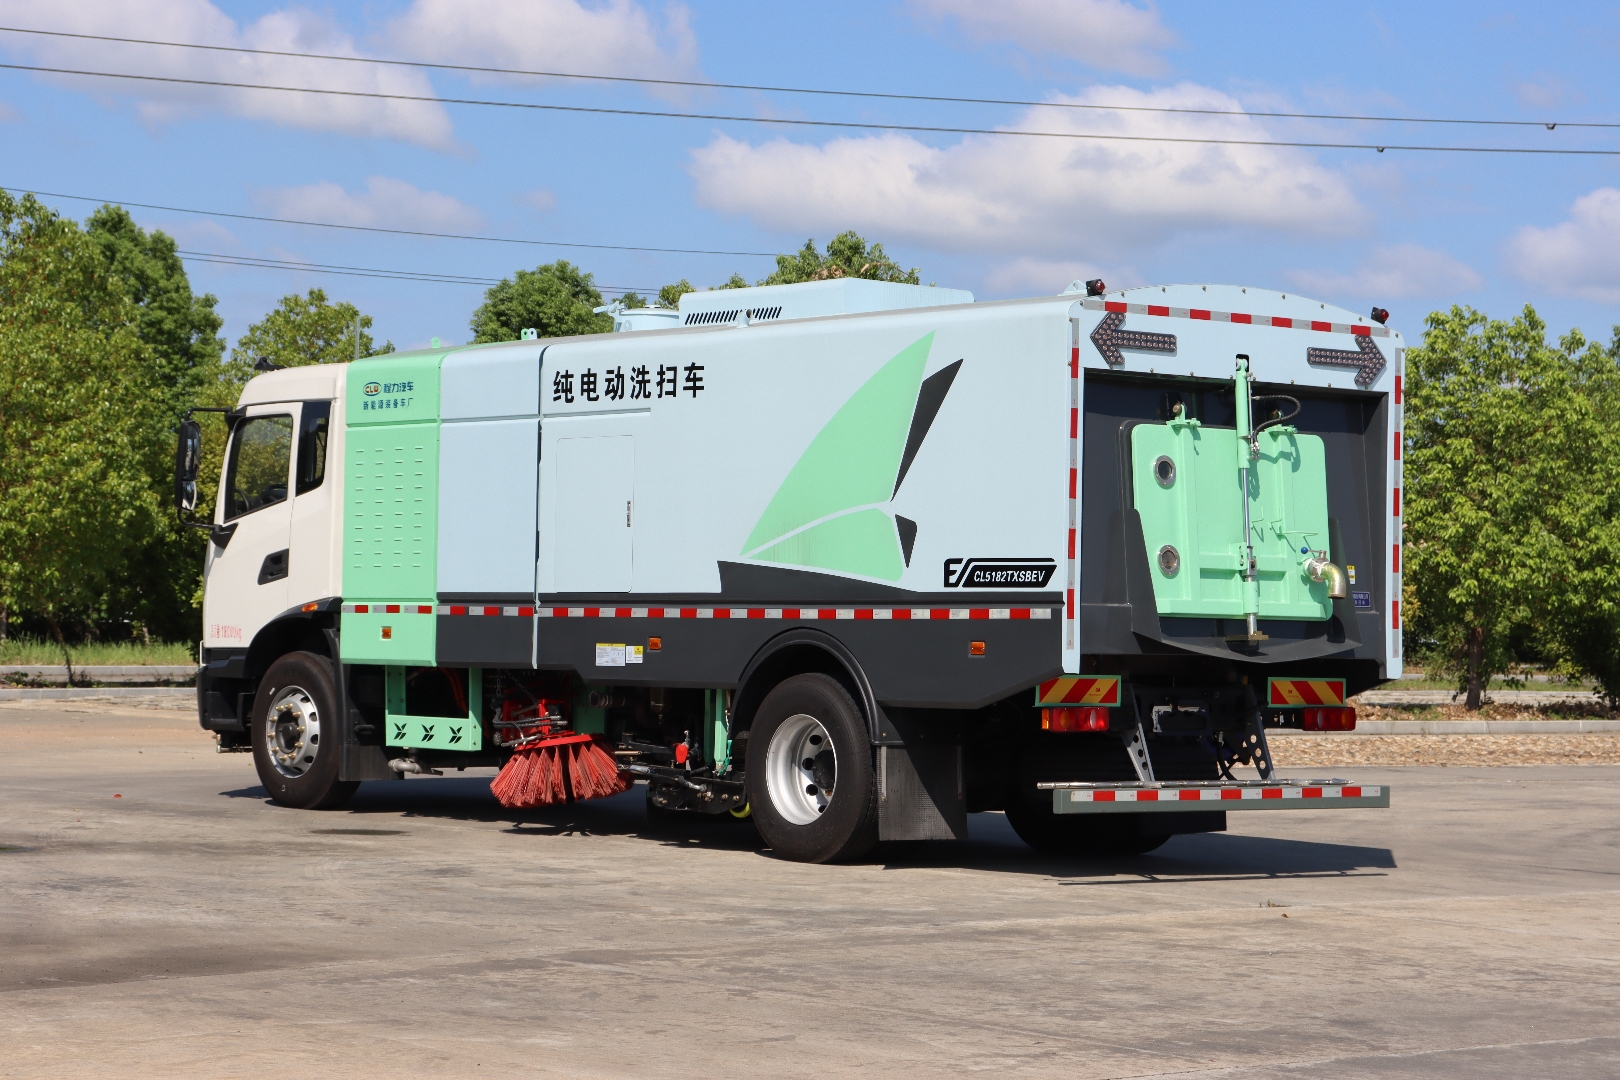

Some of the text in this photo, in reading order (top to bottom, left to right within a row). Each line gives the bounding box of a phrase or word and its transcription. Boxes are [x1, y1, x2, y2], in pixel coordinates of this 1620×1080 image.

[383, 381, 414, 393] 程力汽车
[553, 362, 704, 403] 纯电动洗扫车
[363, 397, 414, 410] 新能源装备车厂
[973, 570, 1046, 582] CL5182TXSBEV
